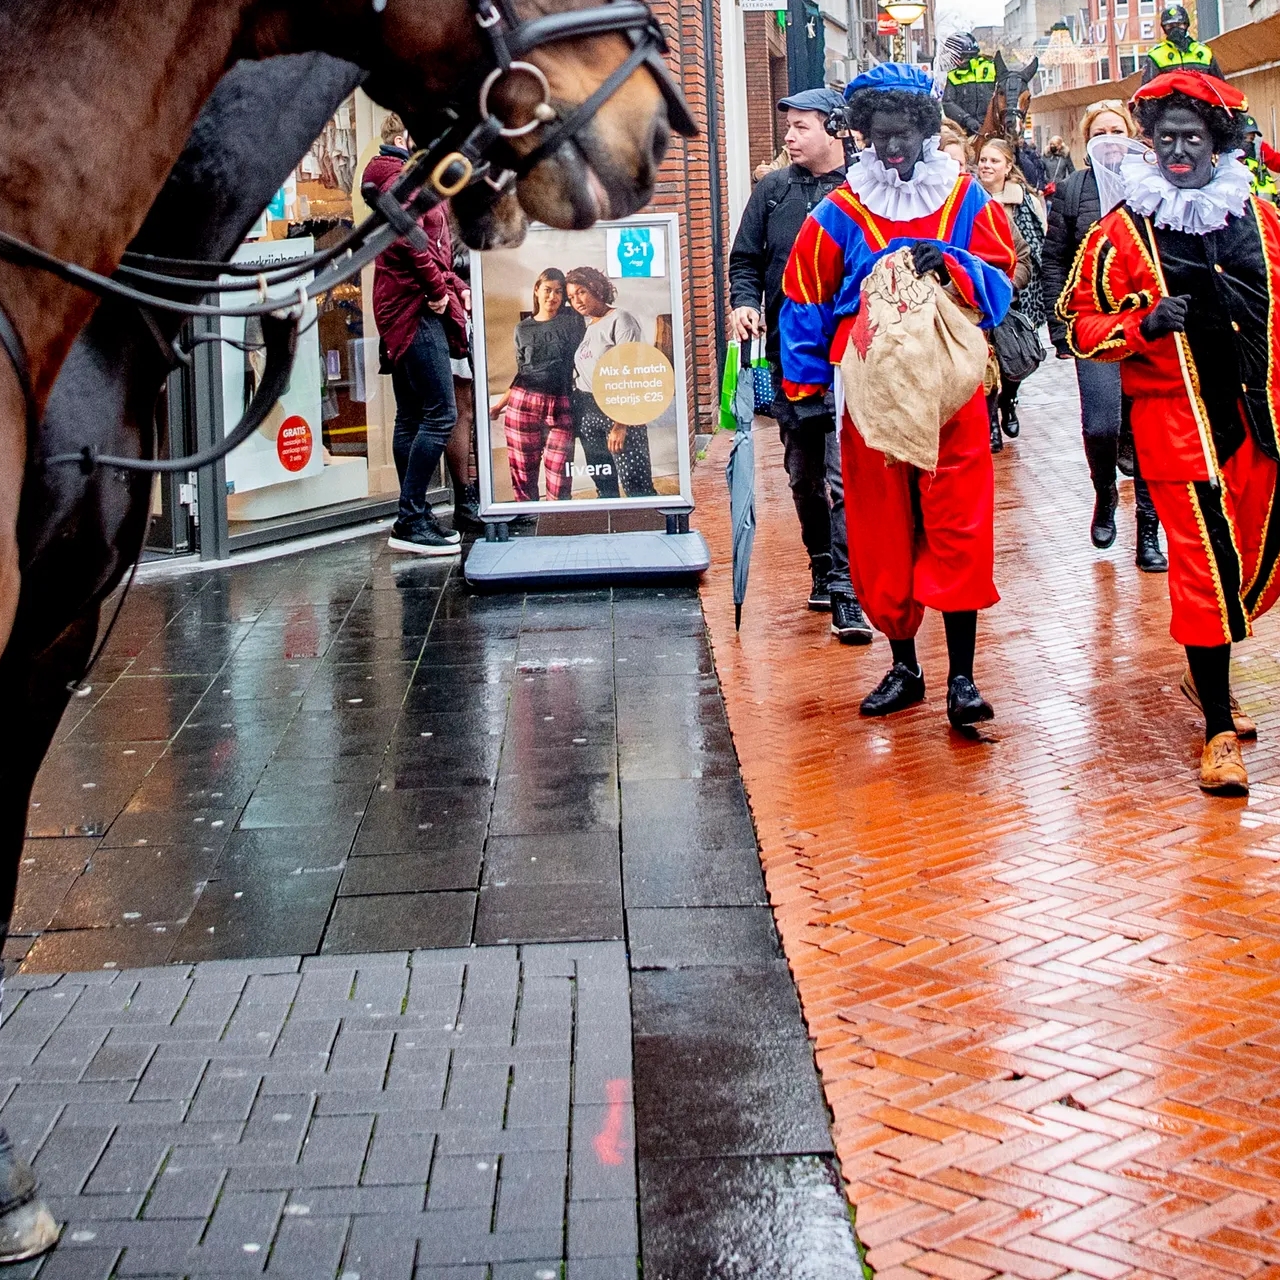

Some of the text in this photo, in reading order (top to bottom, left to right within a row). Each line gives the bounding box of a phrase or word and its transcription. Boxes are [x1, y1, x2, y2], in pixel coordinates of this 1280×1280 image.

[623, 241, 648, 258] 3+1
[599, 362, 667, 377] Mix & match
[605, 378, 663, 391] nachtmode
[605, 391, 664, 406] setprijs €25
[282, 425, 306, 439] GRATIS
[565, 461, 612, 477] livera
